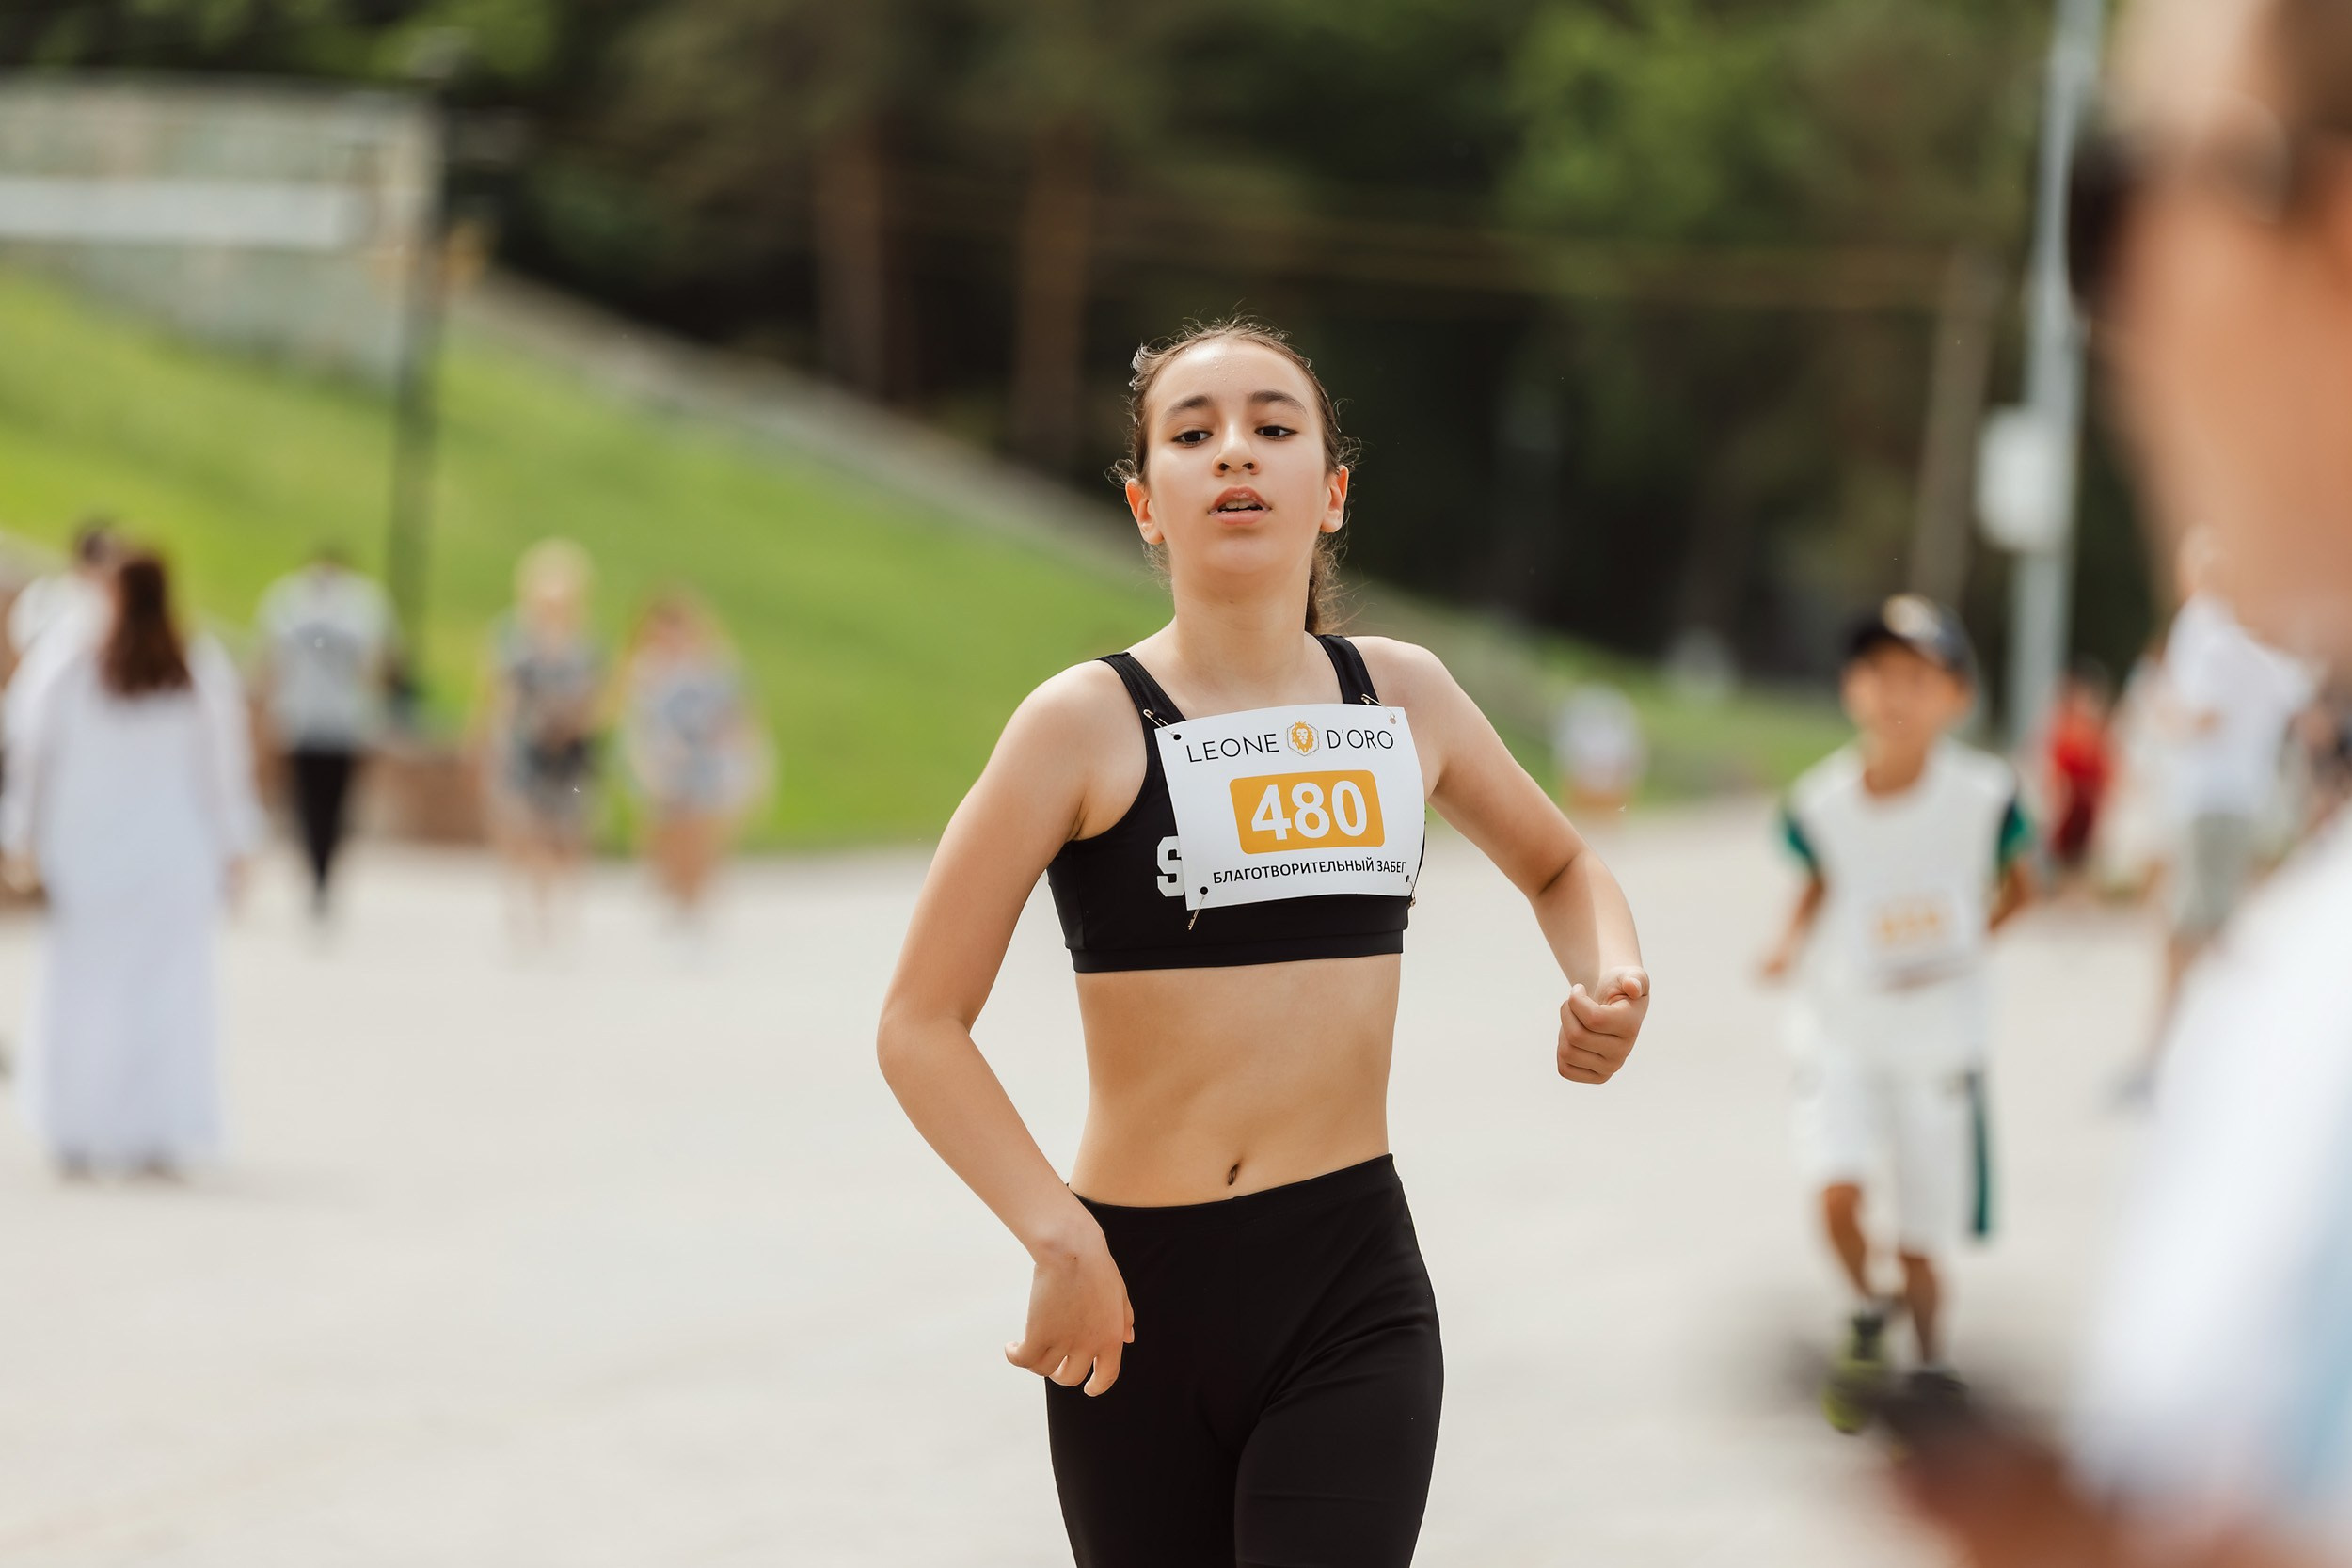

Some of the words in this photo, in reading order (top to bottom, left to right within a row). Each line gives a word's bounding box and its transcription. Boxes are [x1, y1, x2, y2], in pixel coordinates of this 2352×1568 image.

[1186, 733, 1279, 763] LEONE
[1326, 729, 1394, 750] D'ORO
[1250, 780, 1367, 841] 480
[1213, 857, 1375, 884] БЛАГОТВОРИТЕЛЬНЫЙ
[1376, 860, 1406, 874] ЗАБЕГ
